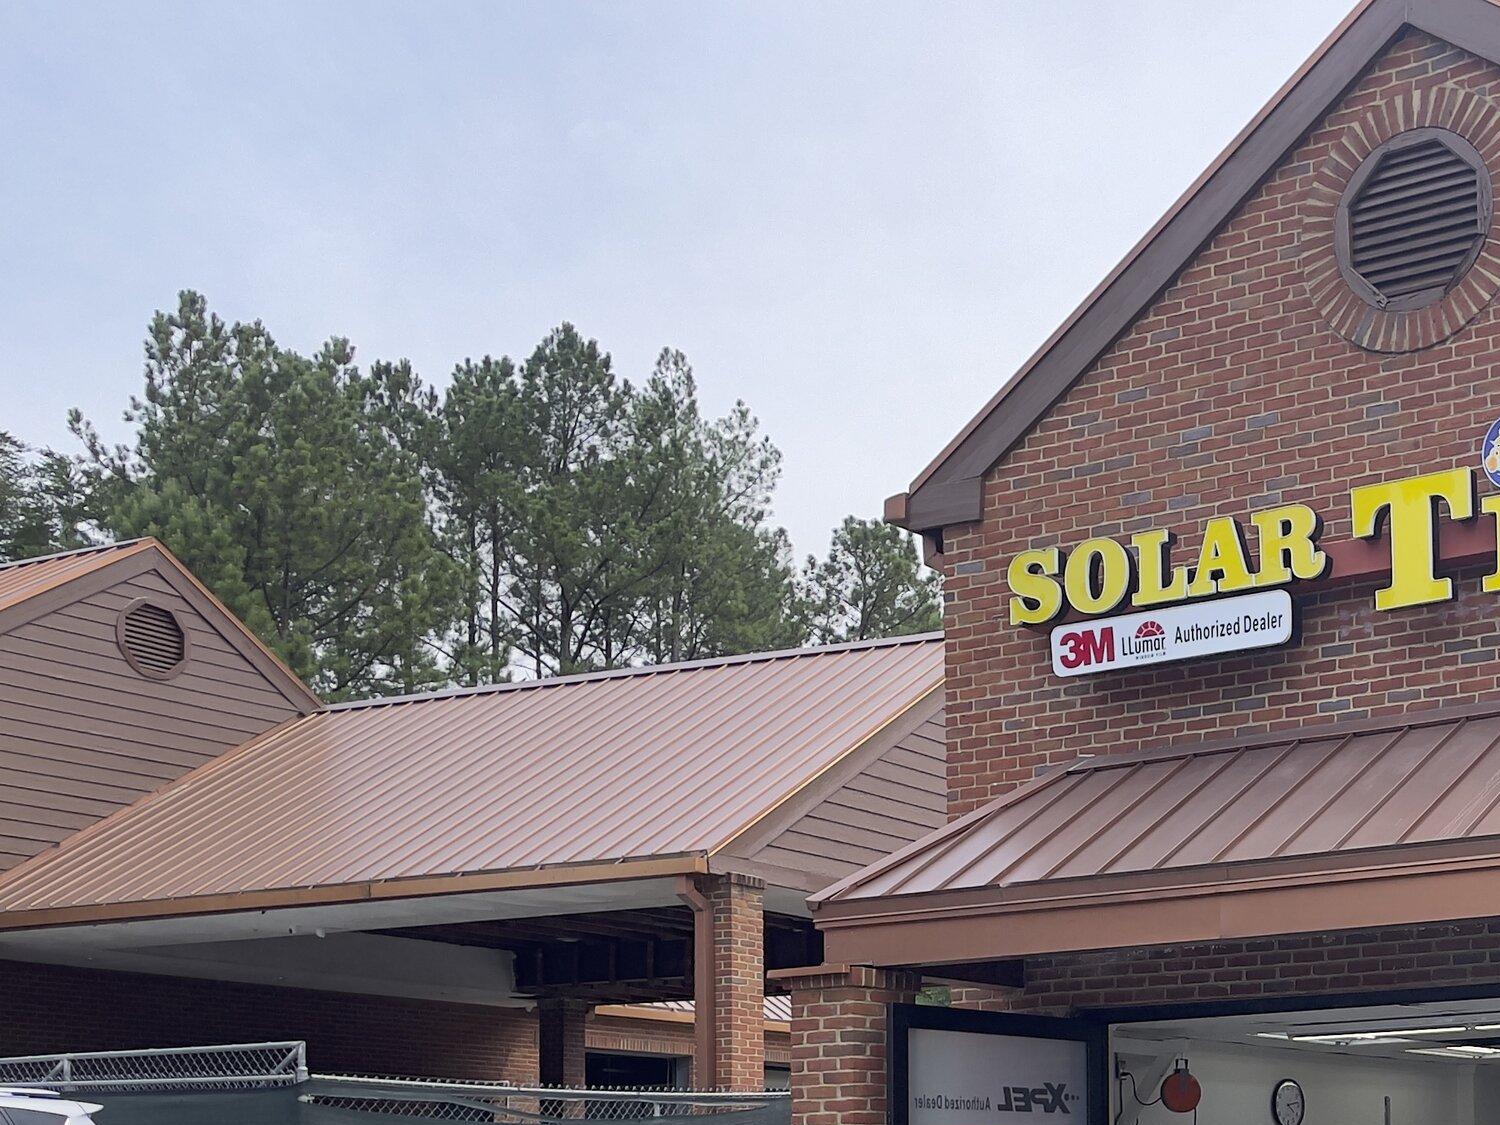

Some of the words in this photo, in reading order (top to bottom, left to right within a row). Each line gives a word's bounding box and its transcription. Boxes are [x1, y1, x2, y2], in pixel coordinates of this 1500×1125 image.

[1008, 504, 1327, 626] SOLAR
[1059, 626, 1115, 669] 3M
[1174, 619, 1241, 645] Authorized
[1243, 611, 1284, 633] Dealer
